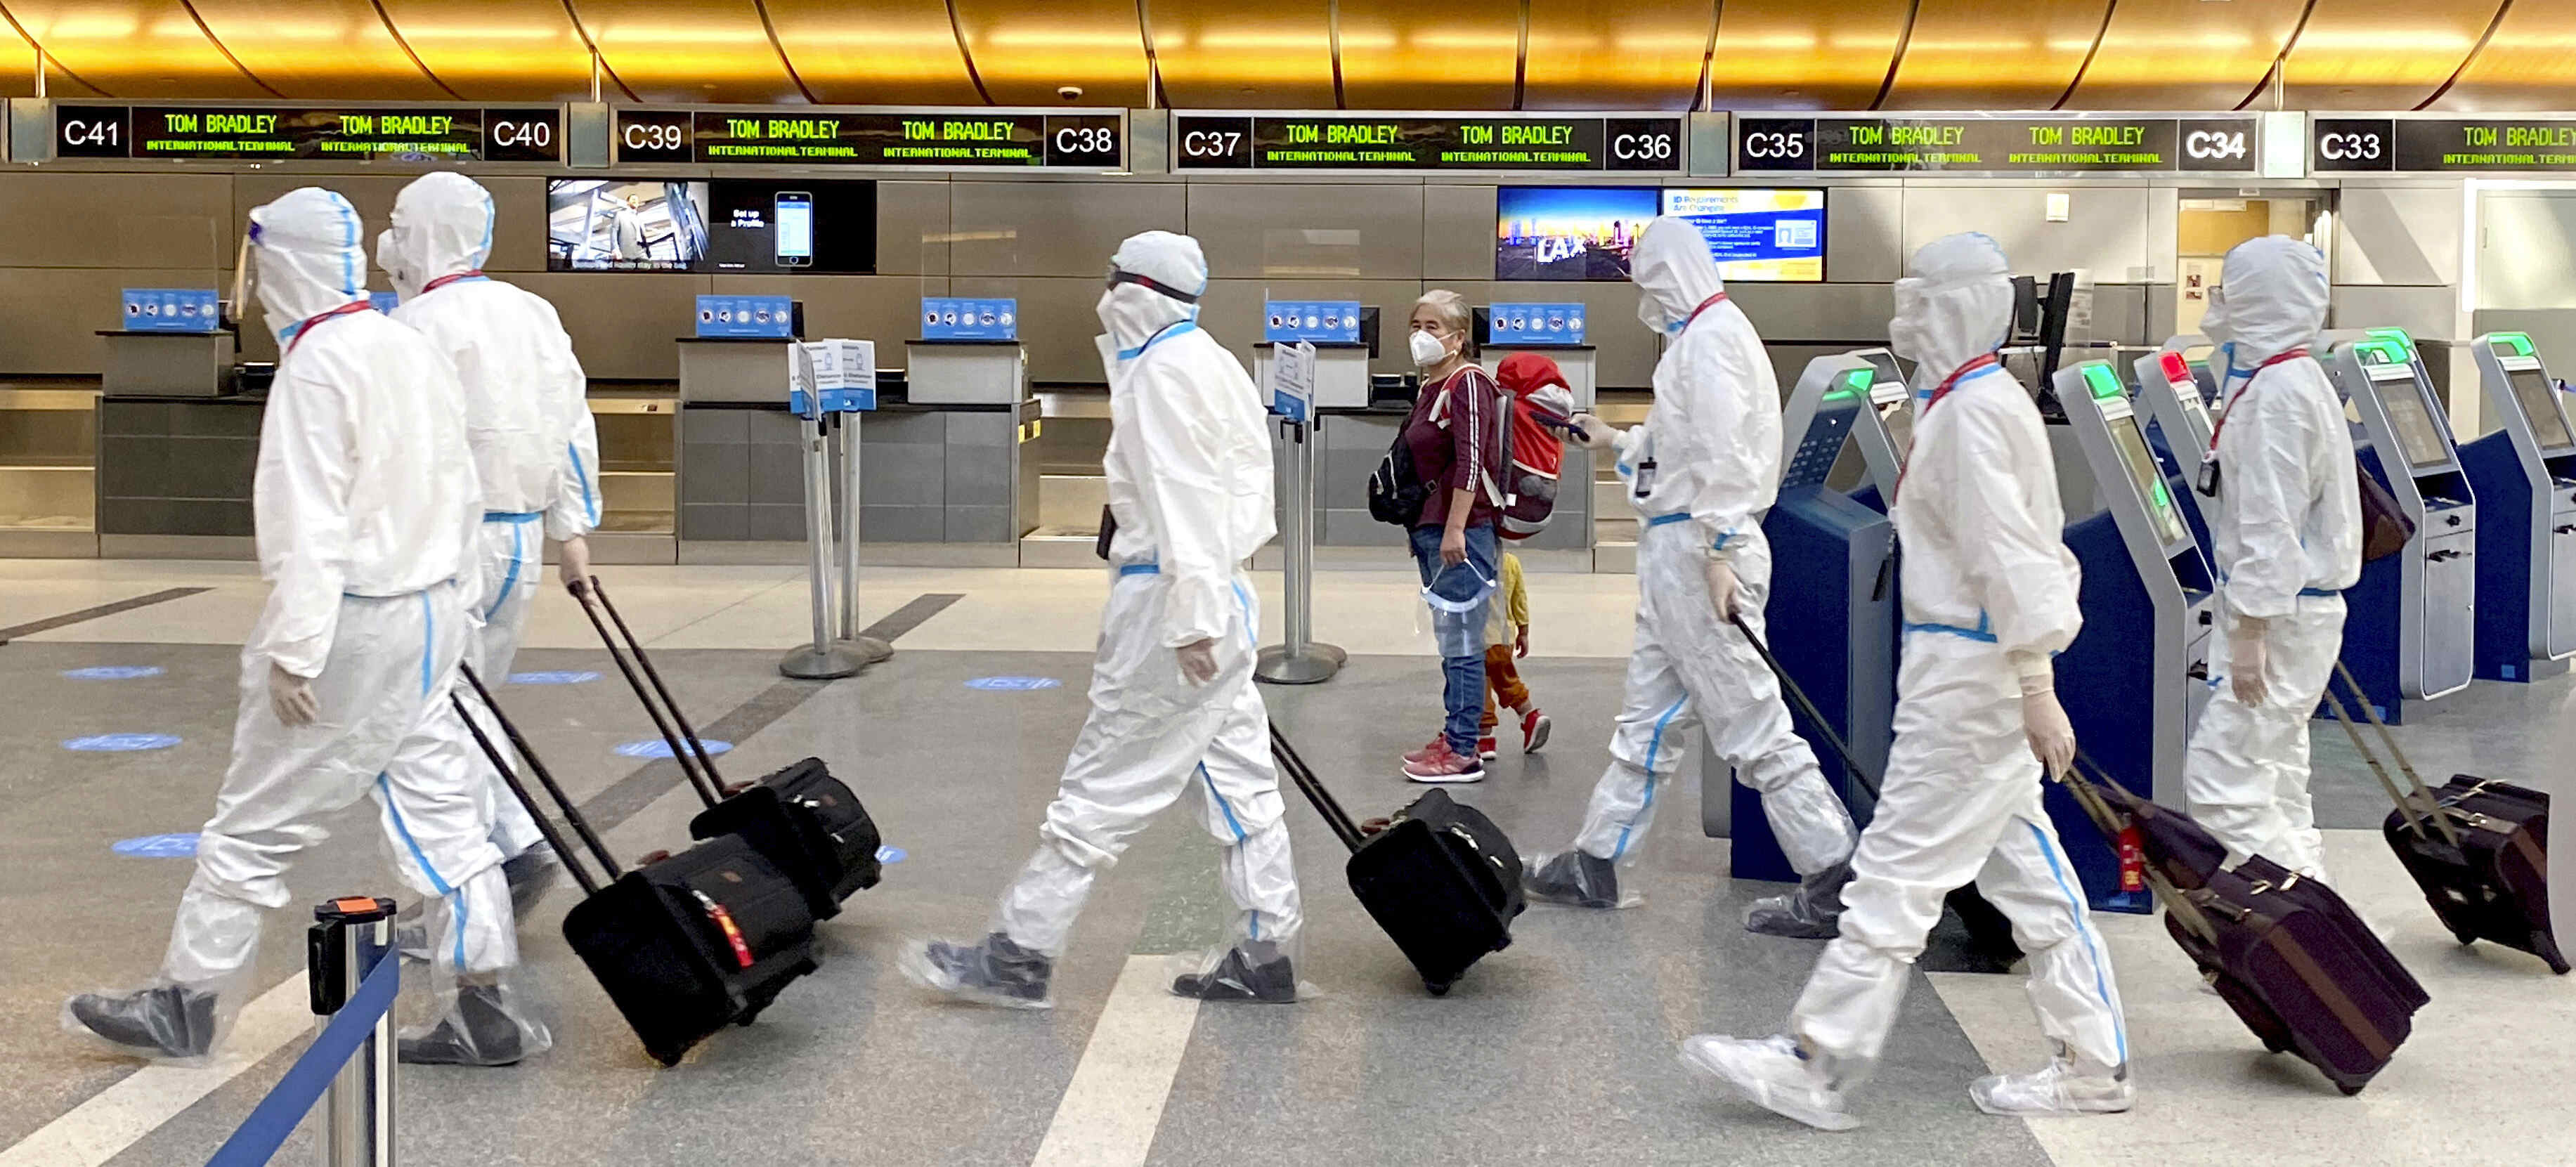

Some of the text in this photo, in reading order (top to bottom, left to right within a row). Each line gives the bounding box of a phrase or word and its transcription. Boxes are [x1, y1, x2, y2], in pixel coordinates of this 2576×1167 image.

[65, 120, 117, 146] C41
[167, 114, 277, 133] TOM BRADLEY
[341, 115, 453, 136] TOM BRADLEY
[727, 119, 840, 139] TOM BRADLEY
[902, 121, 1014, 141] TOM BRADLEY
[494, 121, 550, 147] C40
[625, 124, 682, 150] C39
[1056, 128, 1112, 153] C38
[1185, 131, 1241, 157] C37
[1287, 124, 1398, 144] TOM BRADLEY
[1460, 125, 1573, 145] TOM BRADLEY
[1849, 126, 1965, 147] TOM BRADLEY
[2029, 126, 2145, 145] TOM BRADLEY
[2463, 126, 2497, 147] TOM
[146, 140, 237, 151] INTERNATIONAL
[320, 141, 410, 152] INTERNATIONAL
[708, 145, 800, 157] INTERNATIONAL
[883, 147, 975, 158] INTERNATIONAL
[1614, 133, 1671, 159] C36
[1746, 132, 1804, 158] C35
[2186, 131, 2246, 159] C34
[2321, 133, 2381, 159] C33
[1267, 151, 1358, 162] INTERNATIONAL
[1441, 151, 1532, 162] INTERNATIONAL
[1829, 152, 1920, 164] INTERNATIONAL
[2009, 153, 2102, 164] INTERNATIONAL
[2443, 153, 2576, 165] INTERNATIONAL TERMI
[1537, 235, 1587, 263] LAX
